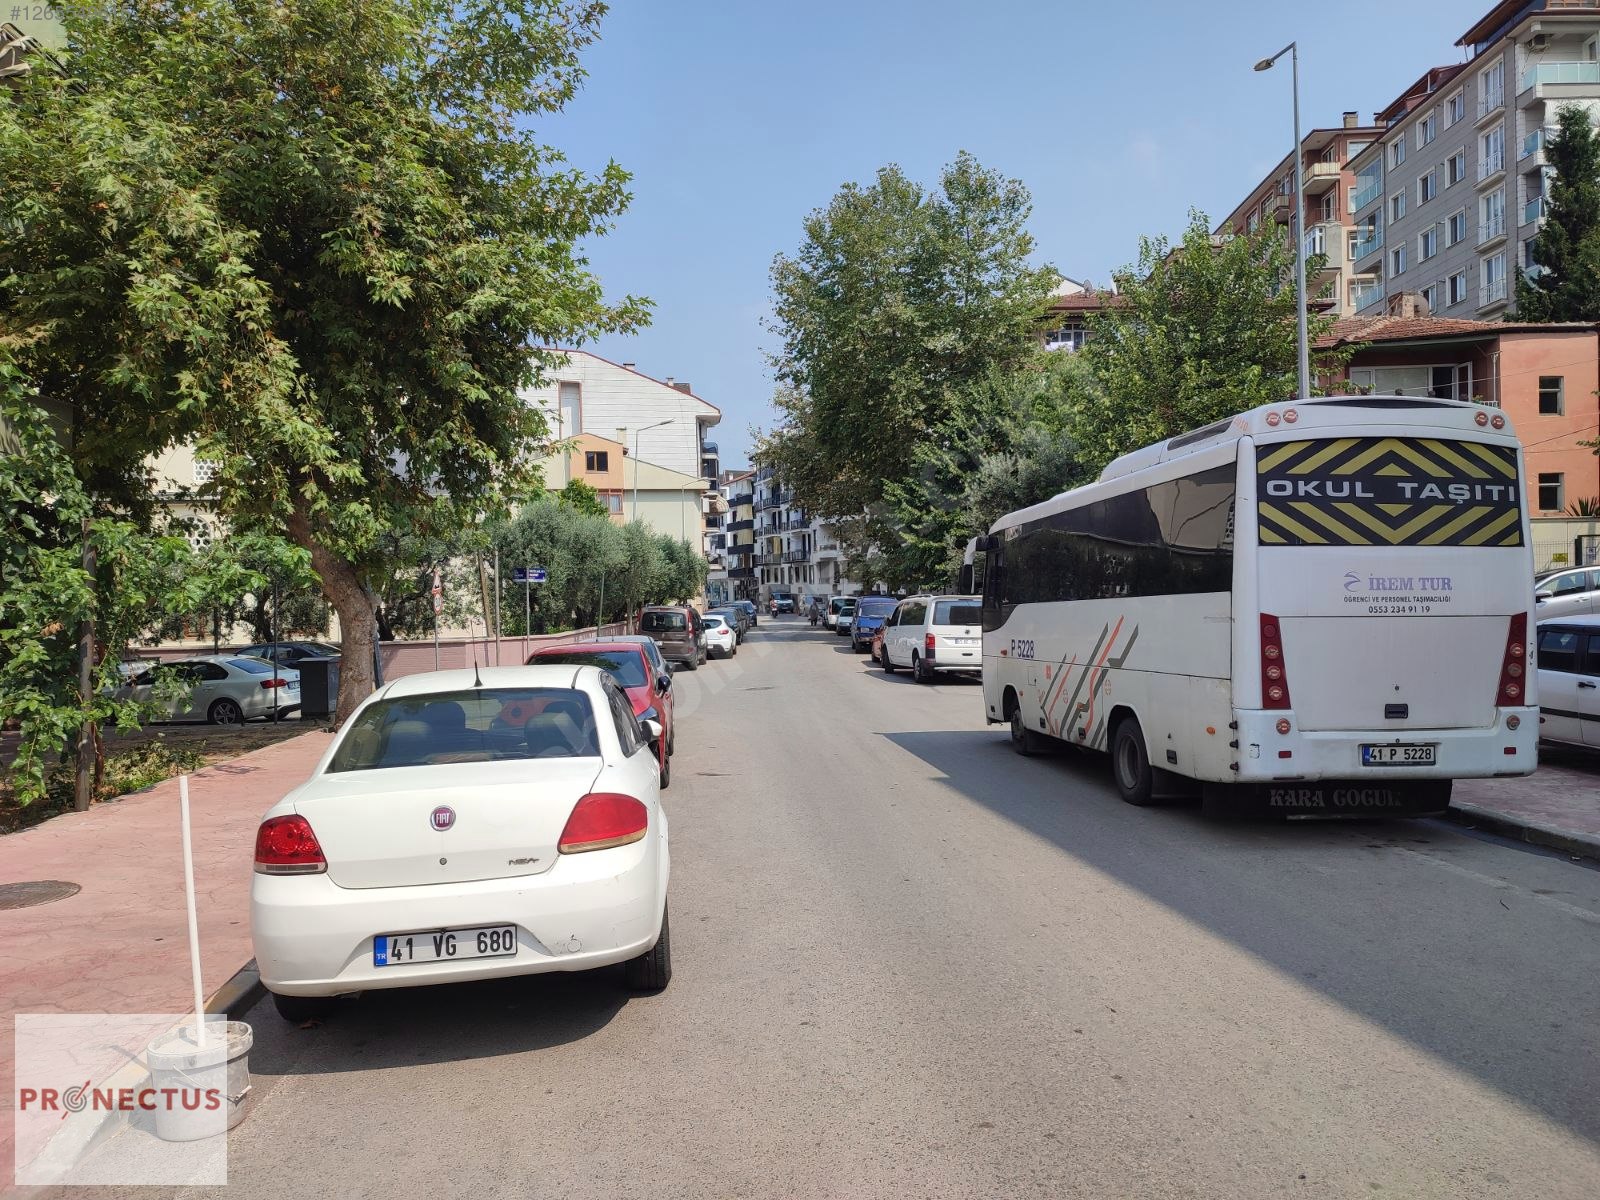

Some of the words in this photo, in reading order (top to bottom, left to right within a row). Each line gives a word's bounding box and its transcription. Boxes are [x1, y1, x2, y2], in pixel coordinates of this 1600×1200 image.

[1266, 479, 1374, 498] OKUL
[1397, 482, 1515, 504] TAŞITI
[1368, 573, 1414, 591] İREM
[1418, 577, 1453, 591] TUR
[1368, 605, 1388, 614] 0553
[1390, 605, 1406, 614] 234
[1408, 605, 1417, 613] 91
[1421, 605, 1431, 613] 19
[1011, 639, 1016, 657] P
[1017, 639, 1035, 659] 5228
[1370, 748, 1383, 761] 41
[1389, 748, 1397, 761] P
[1404, 748, 1432, 761] 5228
[1269, 789, 1325, 807] KARA
[436, 813, 450, 824] FIAT
[391, 937, 413, 961] 41
[433, 934, 457, 958] VG
[476, 929, 513, 954] 680
